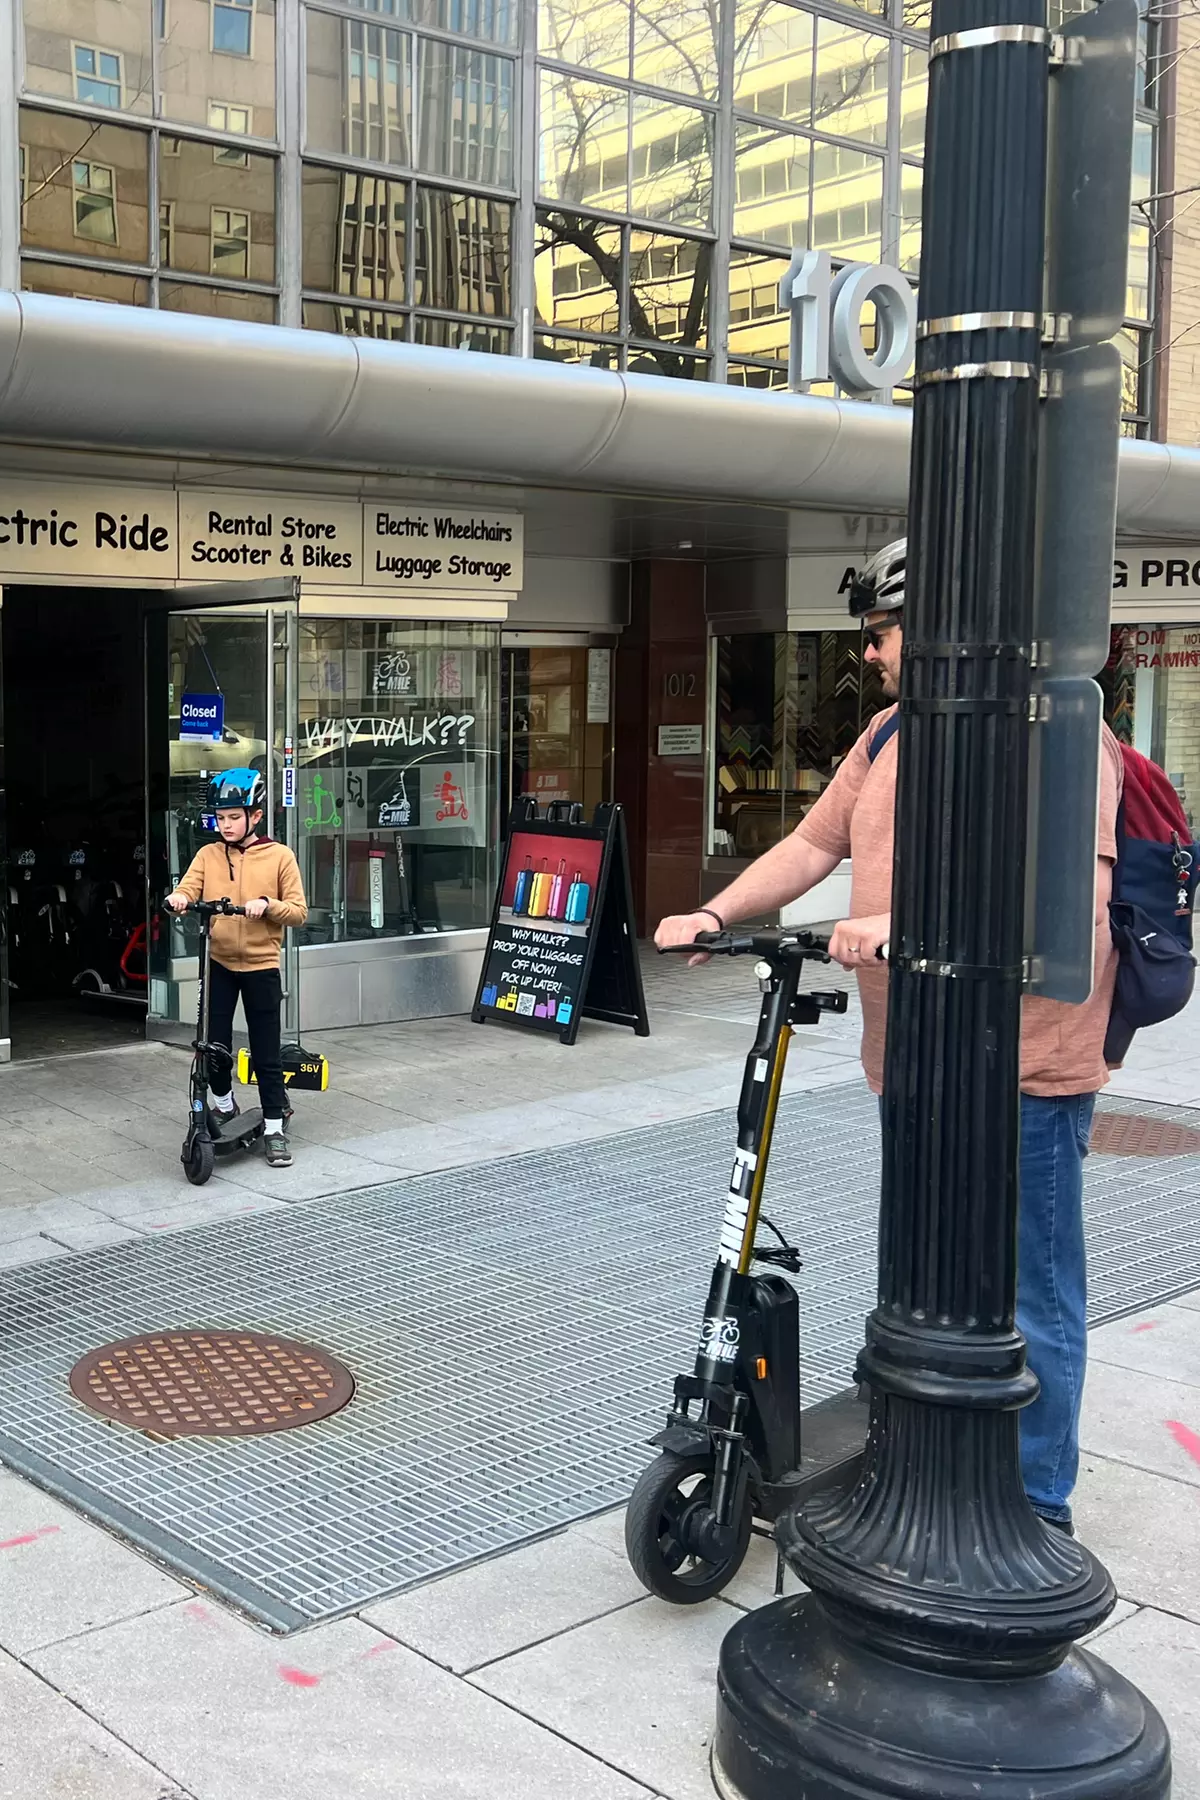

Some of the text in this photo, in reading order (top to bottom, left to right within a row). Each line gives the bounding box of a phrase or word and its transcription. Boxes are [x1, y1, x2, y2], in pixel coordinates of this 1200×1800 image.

[95, 511, 169, 552] Ride
[208, 510, 337, 540] Rental Store
[376, 512, 513, 542] Electric Wheelchairs
[191, 540, 352, 569] Scooter & Bikes
[375, 552, 512, 582] Luggage Storage
[664, 673, 697, 697] 1012
[182, 704, 217, 719] Closed
[304, 715, 476, 748] WHY WALK??
[512, 929, 570, 947] WHY WALK??
[493, 940, 584, 966] DROP YOUR LUGGAGE
[511, 959, 557, 978] OFF NOW!
[501, 971, 562, 994] PICK UP LATER!
[300, 1063, 320, 1073] 36V
